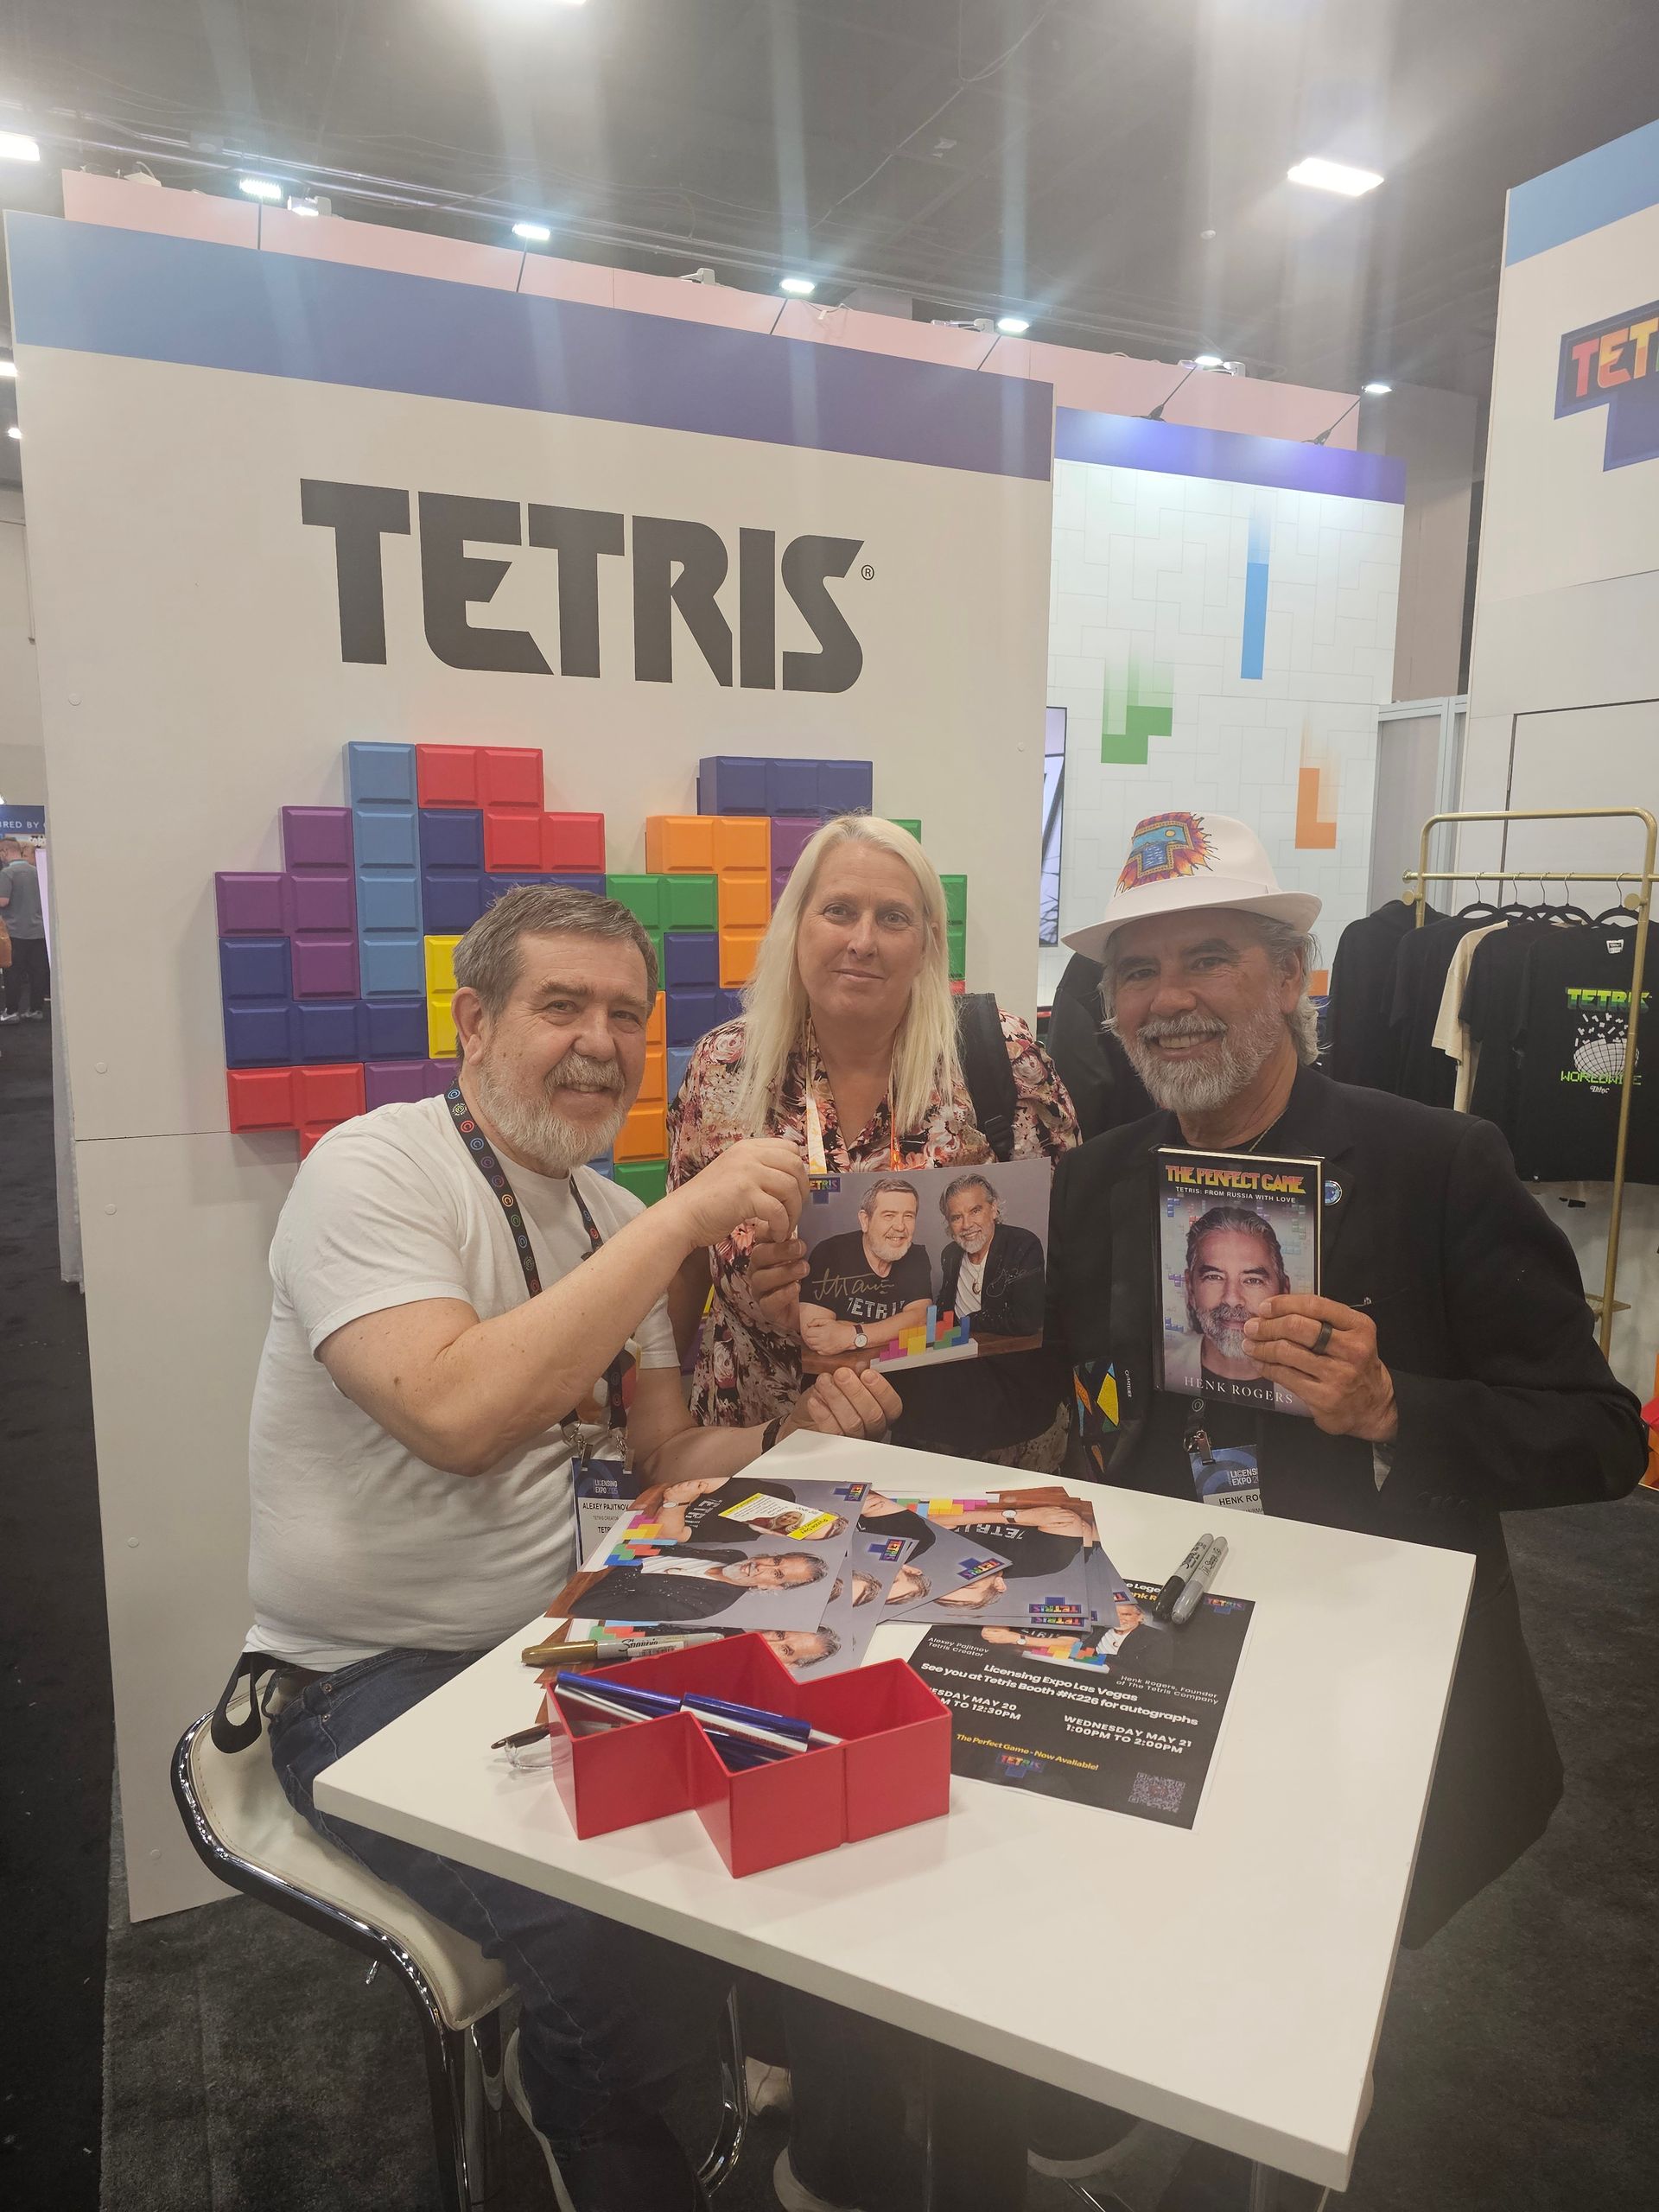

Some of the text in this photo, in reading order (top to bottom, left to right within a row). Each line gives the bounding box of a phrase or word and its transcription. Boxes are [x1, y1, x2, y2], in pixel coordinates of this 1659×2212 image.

[1571, 317, 1659, 397] TET
[1560, 1071, 1642, 1085] WORLDWIE
[810, 1179, 838, 1190] ETRIS
[1166, 1165, 1306, 1194] THE PERFECT GAME
[1184, 1376, 1293, 1404] HENK ROGERS
[1231, 1477, 1252, 1486] EXPO
[1219, 1496, 1244, 1505] HENK
[1032, 1605, 1079, 1613] TETRIS
[928, 1637, 989, 1653] Alexey Pajitnov
[929, 1642, 984, 1657] Tetris Creator
[983, 1664, 1139, 1701] Licensing Expo Las Vegas
[1121, 1675, 1217, 1699] Henk Rogers, Founder
[920, 1662, 944, 1673] See
[944, 1668, 968, 1678] you
[984, 1675, 1017, 1689] Tetris
[1018, 1682, 1055, 1697] Booth
[1056, 1689, 1099, 1706] #K226
[1100, 1696, 1120, 1709] for
[1120, 1704, 1199, 1726] autographs
[930, 1688, 969, 1700] ESDAY
[971, 1696, 1001, 1707] MAY
[1147, 1685, 1171, 1694] Tetris
[1173, 1691, 1218, 1705] Company
[971, 1704, 1021, 1720] 12:30PM
[1064, 1715, 1192, 1748] WEDNESDAY MAY 21
[1065, 1724, 1184, 1754] 1:00PM TO 2:00PM
[957, 1733, 972, 1743] The
[973, 1737, 1003, 1749] Perfect
[1003, 1744, 1030, 1755] Game
[1034, 1750, 1055, 1761] Now
[1000, 1755, 1042, 1770] TETRIS
